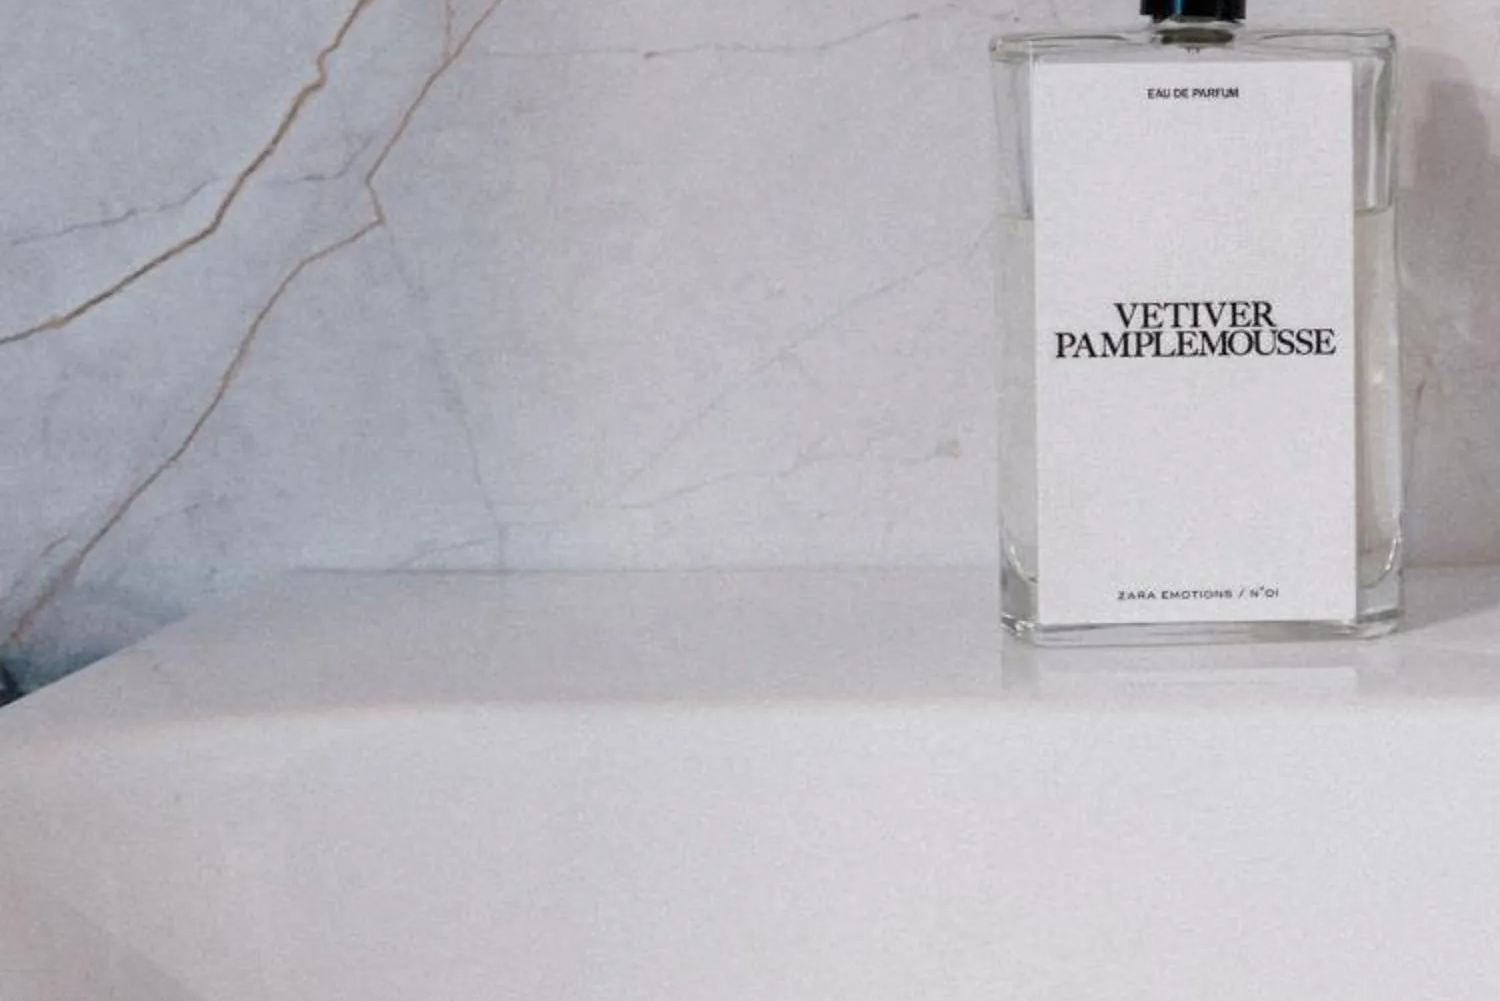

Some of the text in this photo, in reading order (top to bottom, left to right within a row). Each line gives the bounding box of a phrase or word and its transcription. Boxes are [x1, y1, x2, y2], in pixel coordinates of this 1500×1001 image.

[1146, 87, 1240, 100] EAU DE PARFUM
[1113, 300, 1277, 329] VETIVER
[1055, 327, 1337, 359] PAMPLEMOUSSE
[1117, 590, 1157, 600] ZARA
[1161, 589, 1233, 600] EMOTIONS
